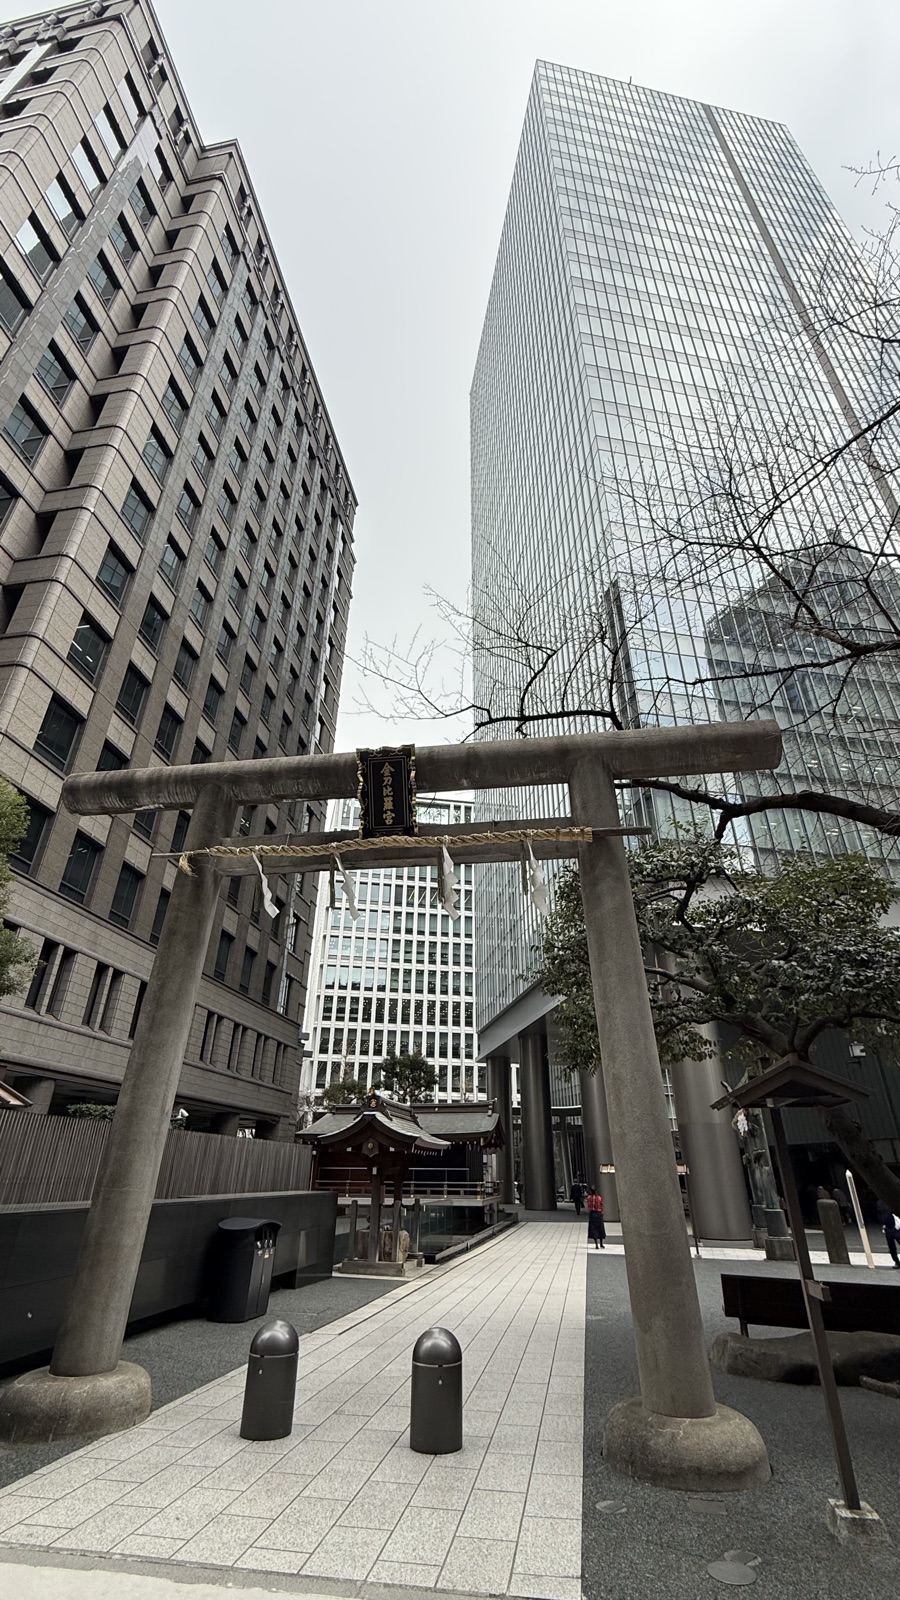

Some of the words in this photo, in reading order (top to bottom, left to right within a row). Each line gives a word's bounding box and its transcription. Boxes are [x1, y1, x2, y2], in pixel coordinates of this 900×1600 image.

[380, 762, 395, 825] 金刀比羅宮
